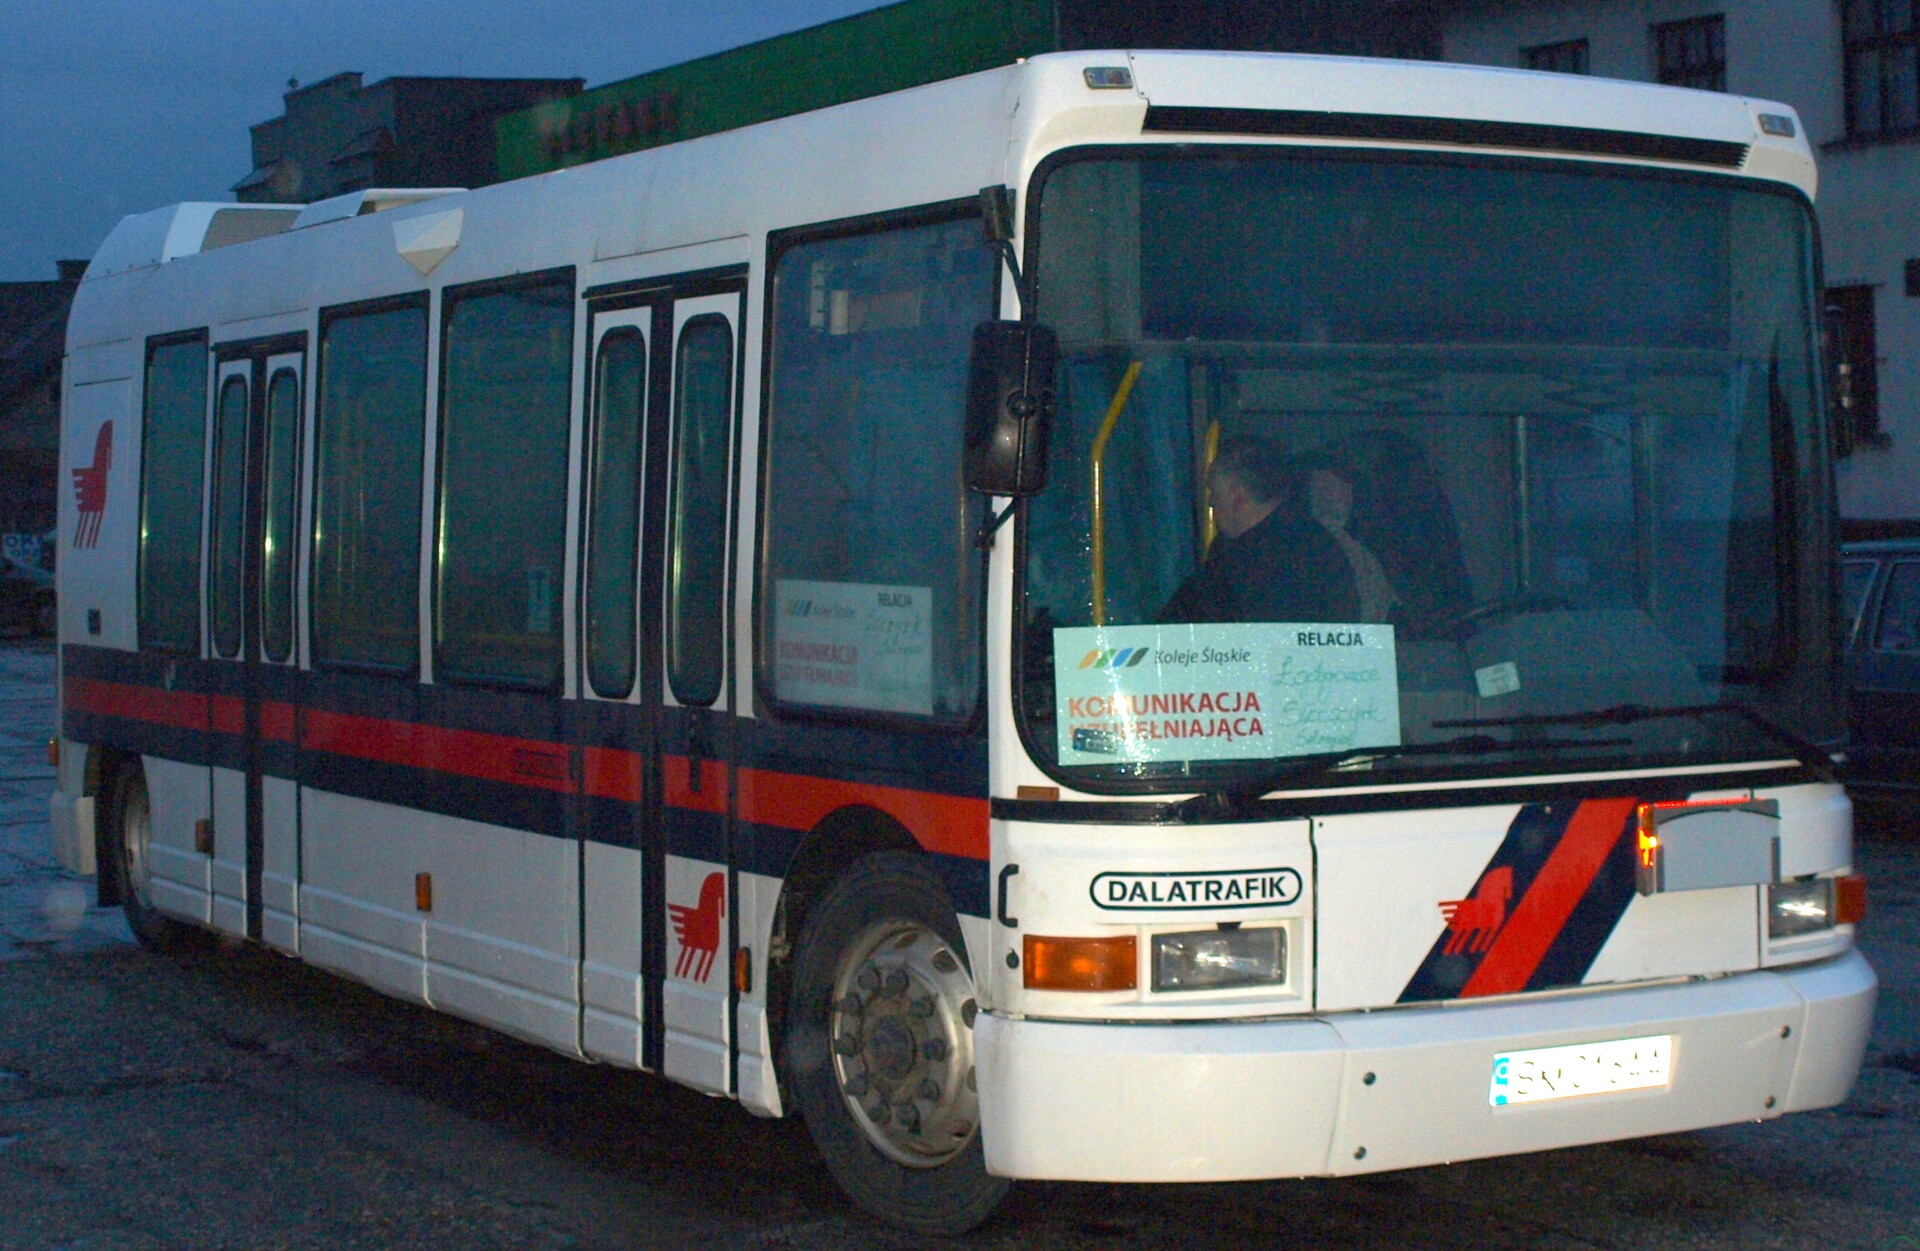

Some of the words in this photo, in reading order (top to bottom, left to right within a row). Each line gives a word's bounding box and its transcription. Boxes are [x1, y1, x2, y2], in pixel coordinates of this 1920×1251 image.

[1297, 632, 1364, 647] RELACJA
[1154, 650, 1198, 667] Koleje
[1201, 646, 1251, 666] Śląskie
[1068, 717, 1264, 742] EŁNIAJĄCA
[1108, 876, 1287, 902] DALATRAFIK
